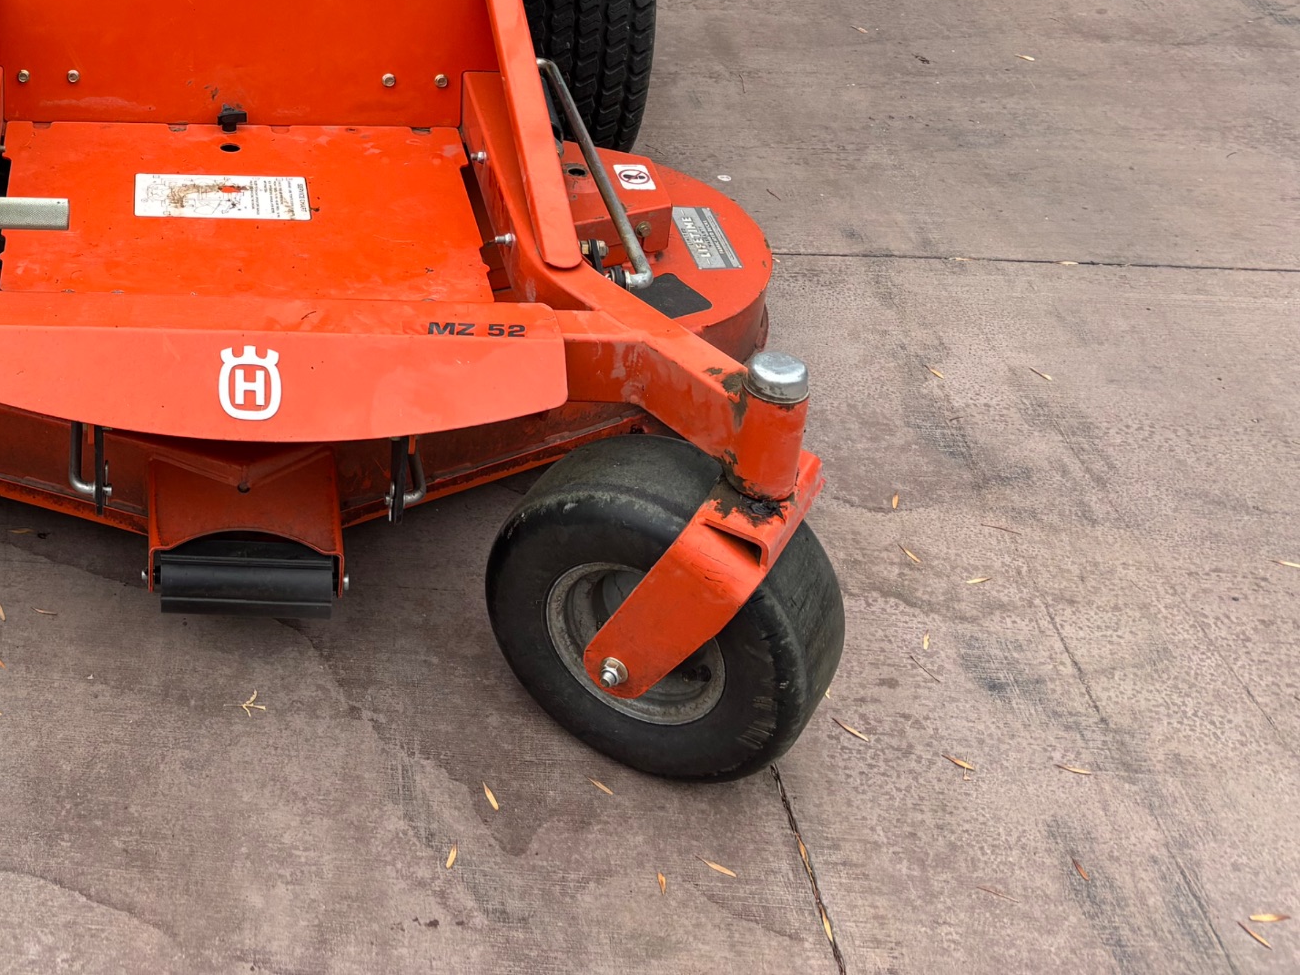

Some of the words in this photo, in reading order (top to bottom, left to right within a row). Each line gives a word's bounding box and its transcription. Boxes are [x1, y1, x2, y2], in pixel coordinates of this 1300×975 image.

[682, 216, 712, 258] LIFETIME
[427, 322, 475, 336] MZ
[487, 323, 526, 337] 52
